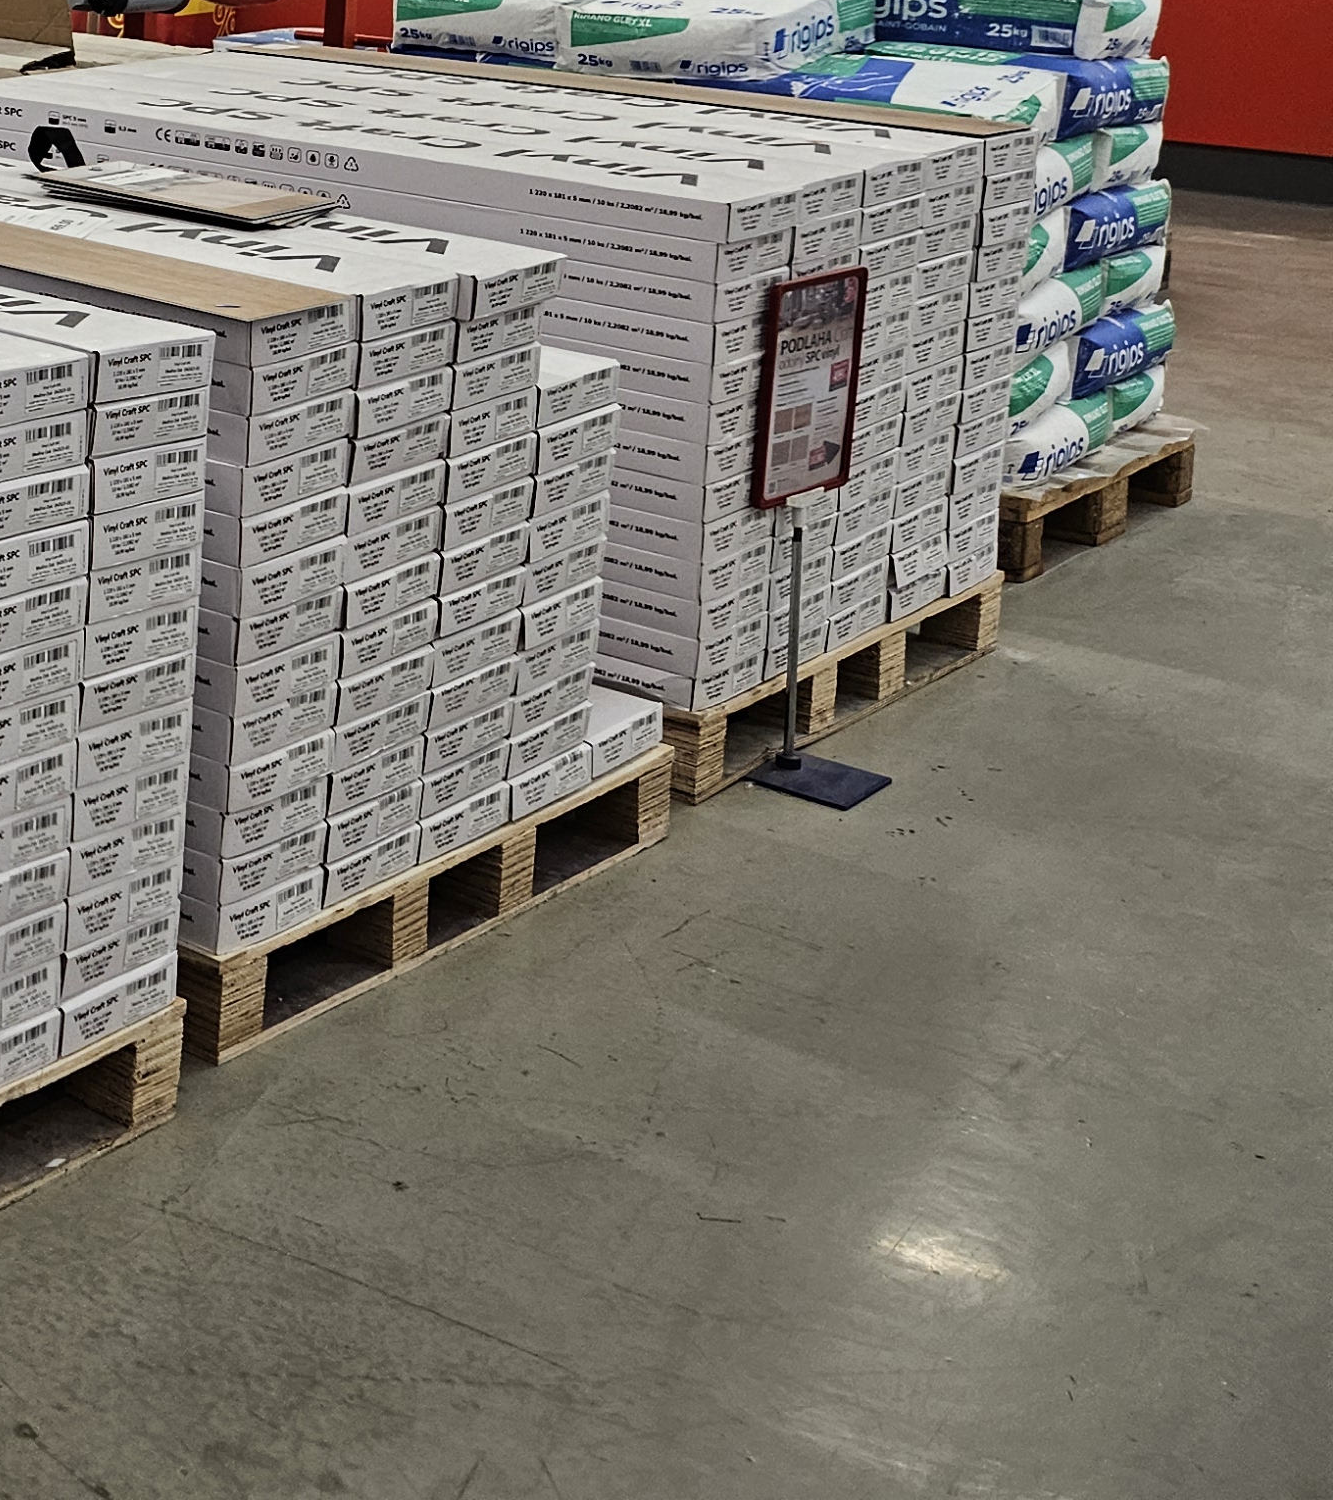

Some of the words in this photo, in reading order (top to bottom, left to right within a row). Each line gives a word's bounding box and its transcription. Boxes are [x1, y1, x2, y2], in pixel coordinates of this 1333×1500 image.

[399, 27, 433, 42] 25kg
[790, 15, 836, 56] rigips
[987, 23, 1028, 39] 25kg
[506, 37, 555, 54] rigips
[577, 53, 614, 68] 25kg
[695, 62, 748, 77] rigips
[4, 105, 23, 118] SPC
[1092, 84, 1132, 118] rigips
[1097, 211, 1135, 248] rigips
[1035, 308, 1077, 350] rigips
[779, 330, 832, 355] PODLAHA
[1106, 339, 1144, 379] rigips
[1043, 438, 1084, 479] rigips
